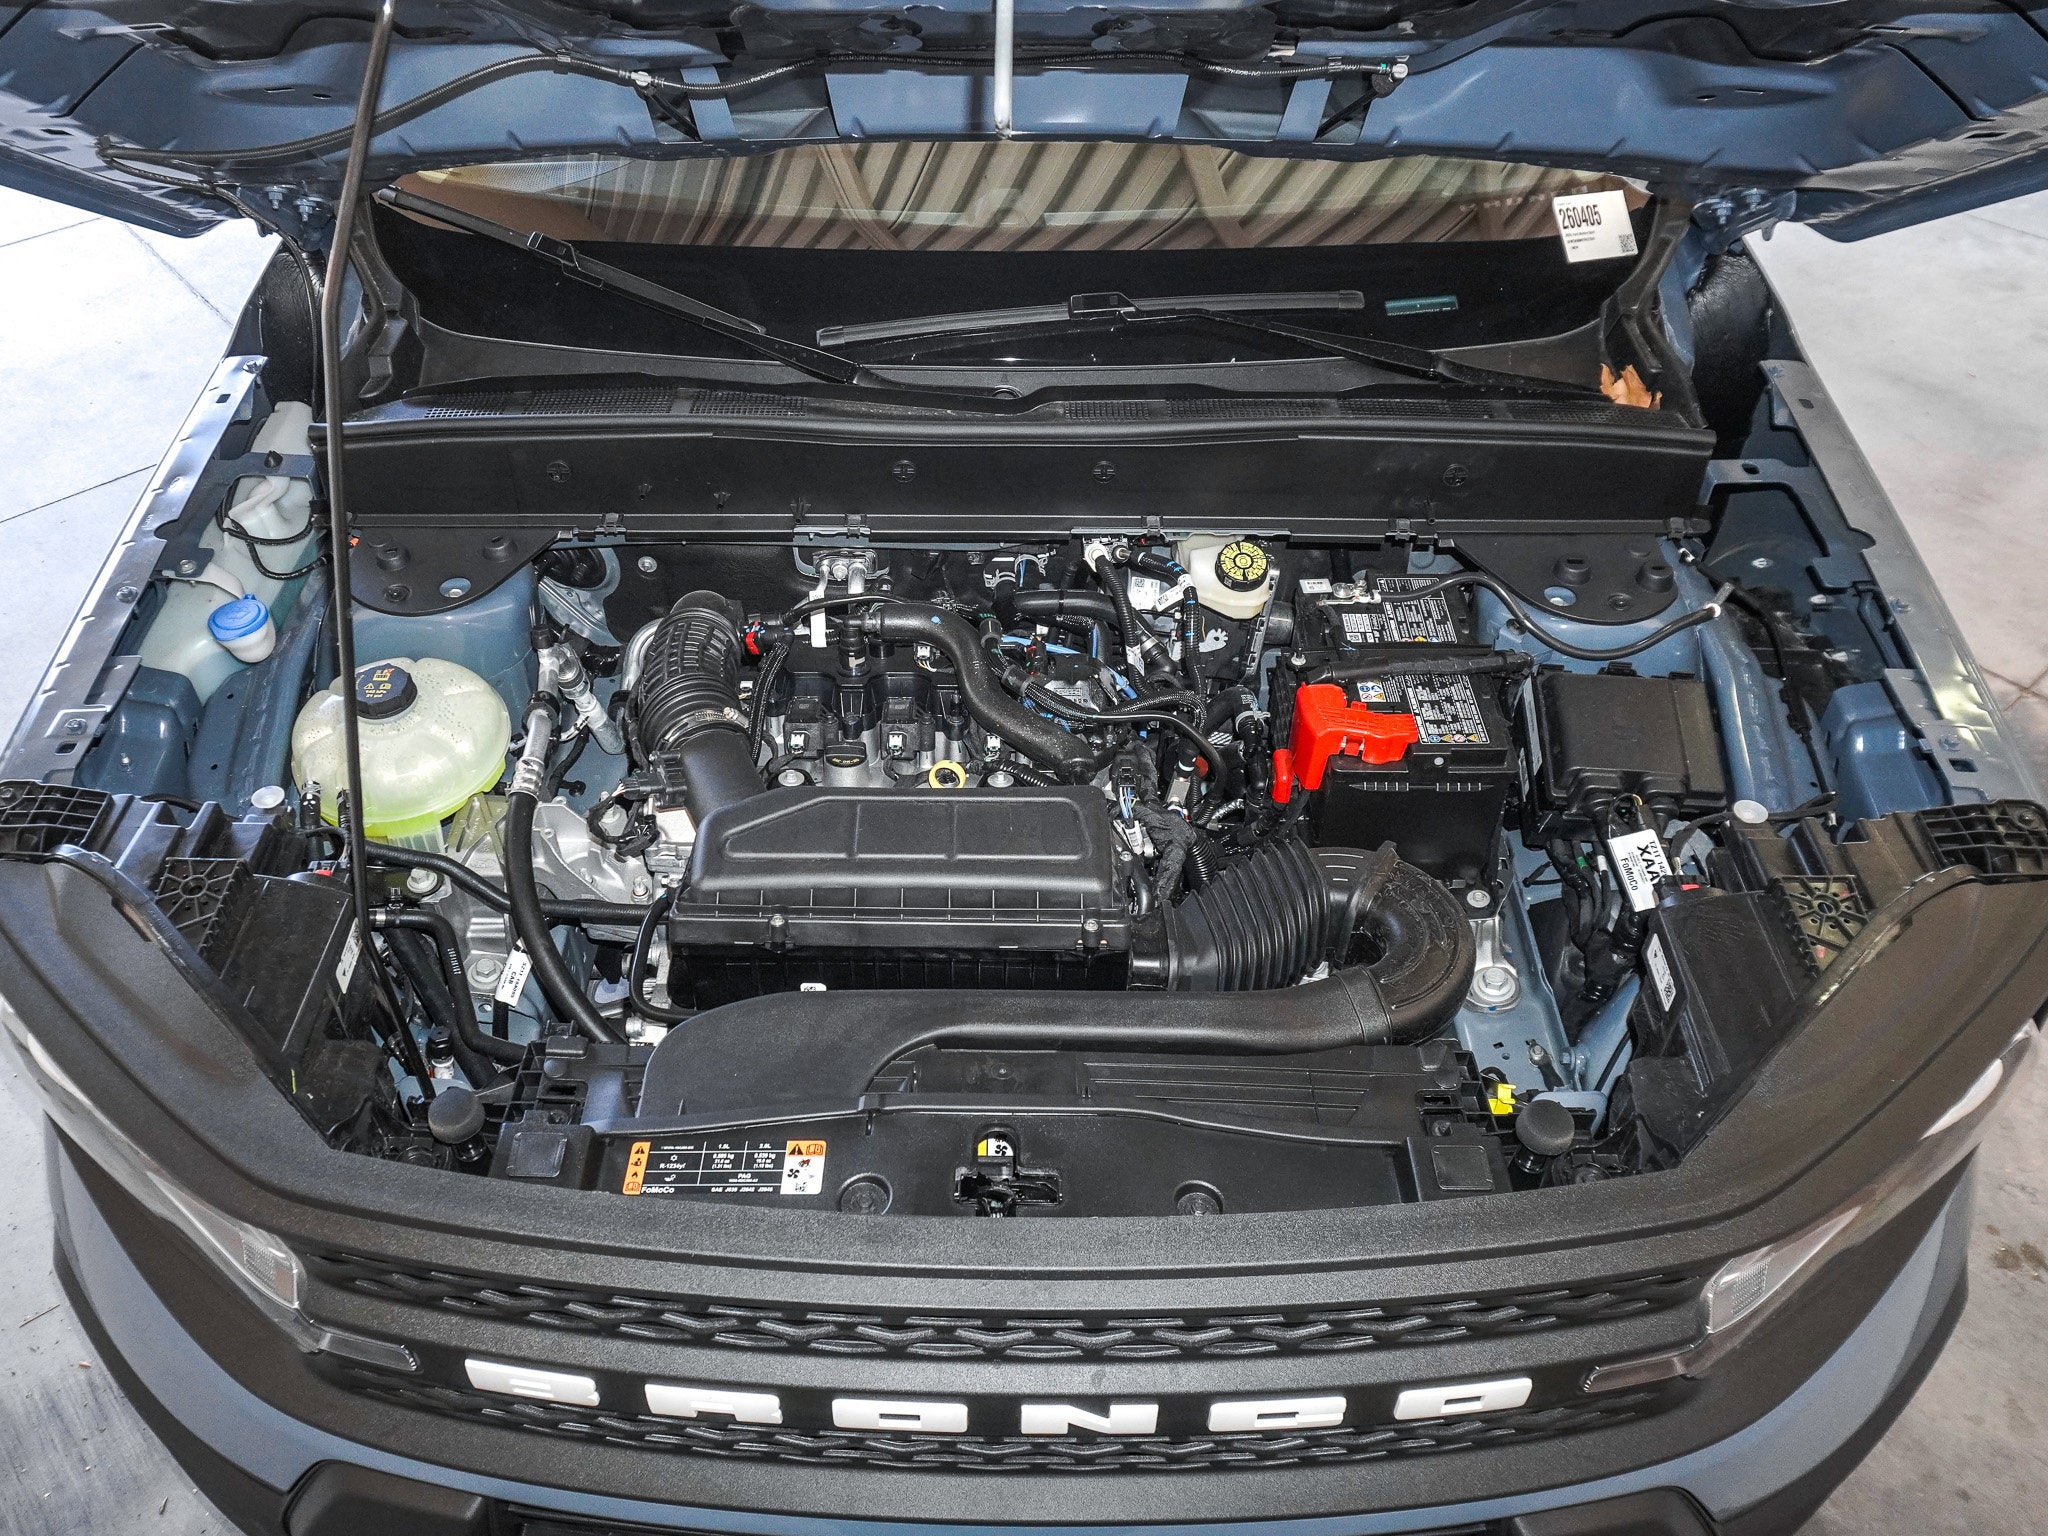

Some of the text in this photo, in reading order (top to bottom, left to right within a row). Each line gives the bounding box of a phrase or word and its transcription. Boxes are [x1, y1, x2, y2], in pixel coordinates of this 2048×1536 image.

[1559, 204, 1602, 230] 260405
[1620, 857, 1639, 891] FoMoCo
[1636, 844, 1661, 883] XAA
[659, 1162, 686, 1170] R-1234yf
[640, 1186, 675, 1194] FoMoCo
[464, 1358, 1533, 1436] BRONCO
